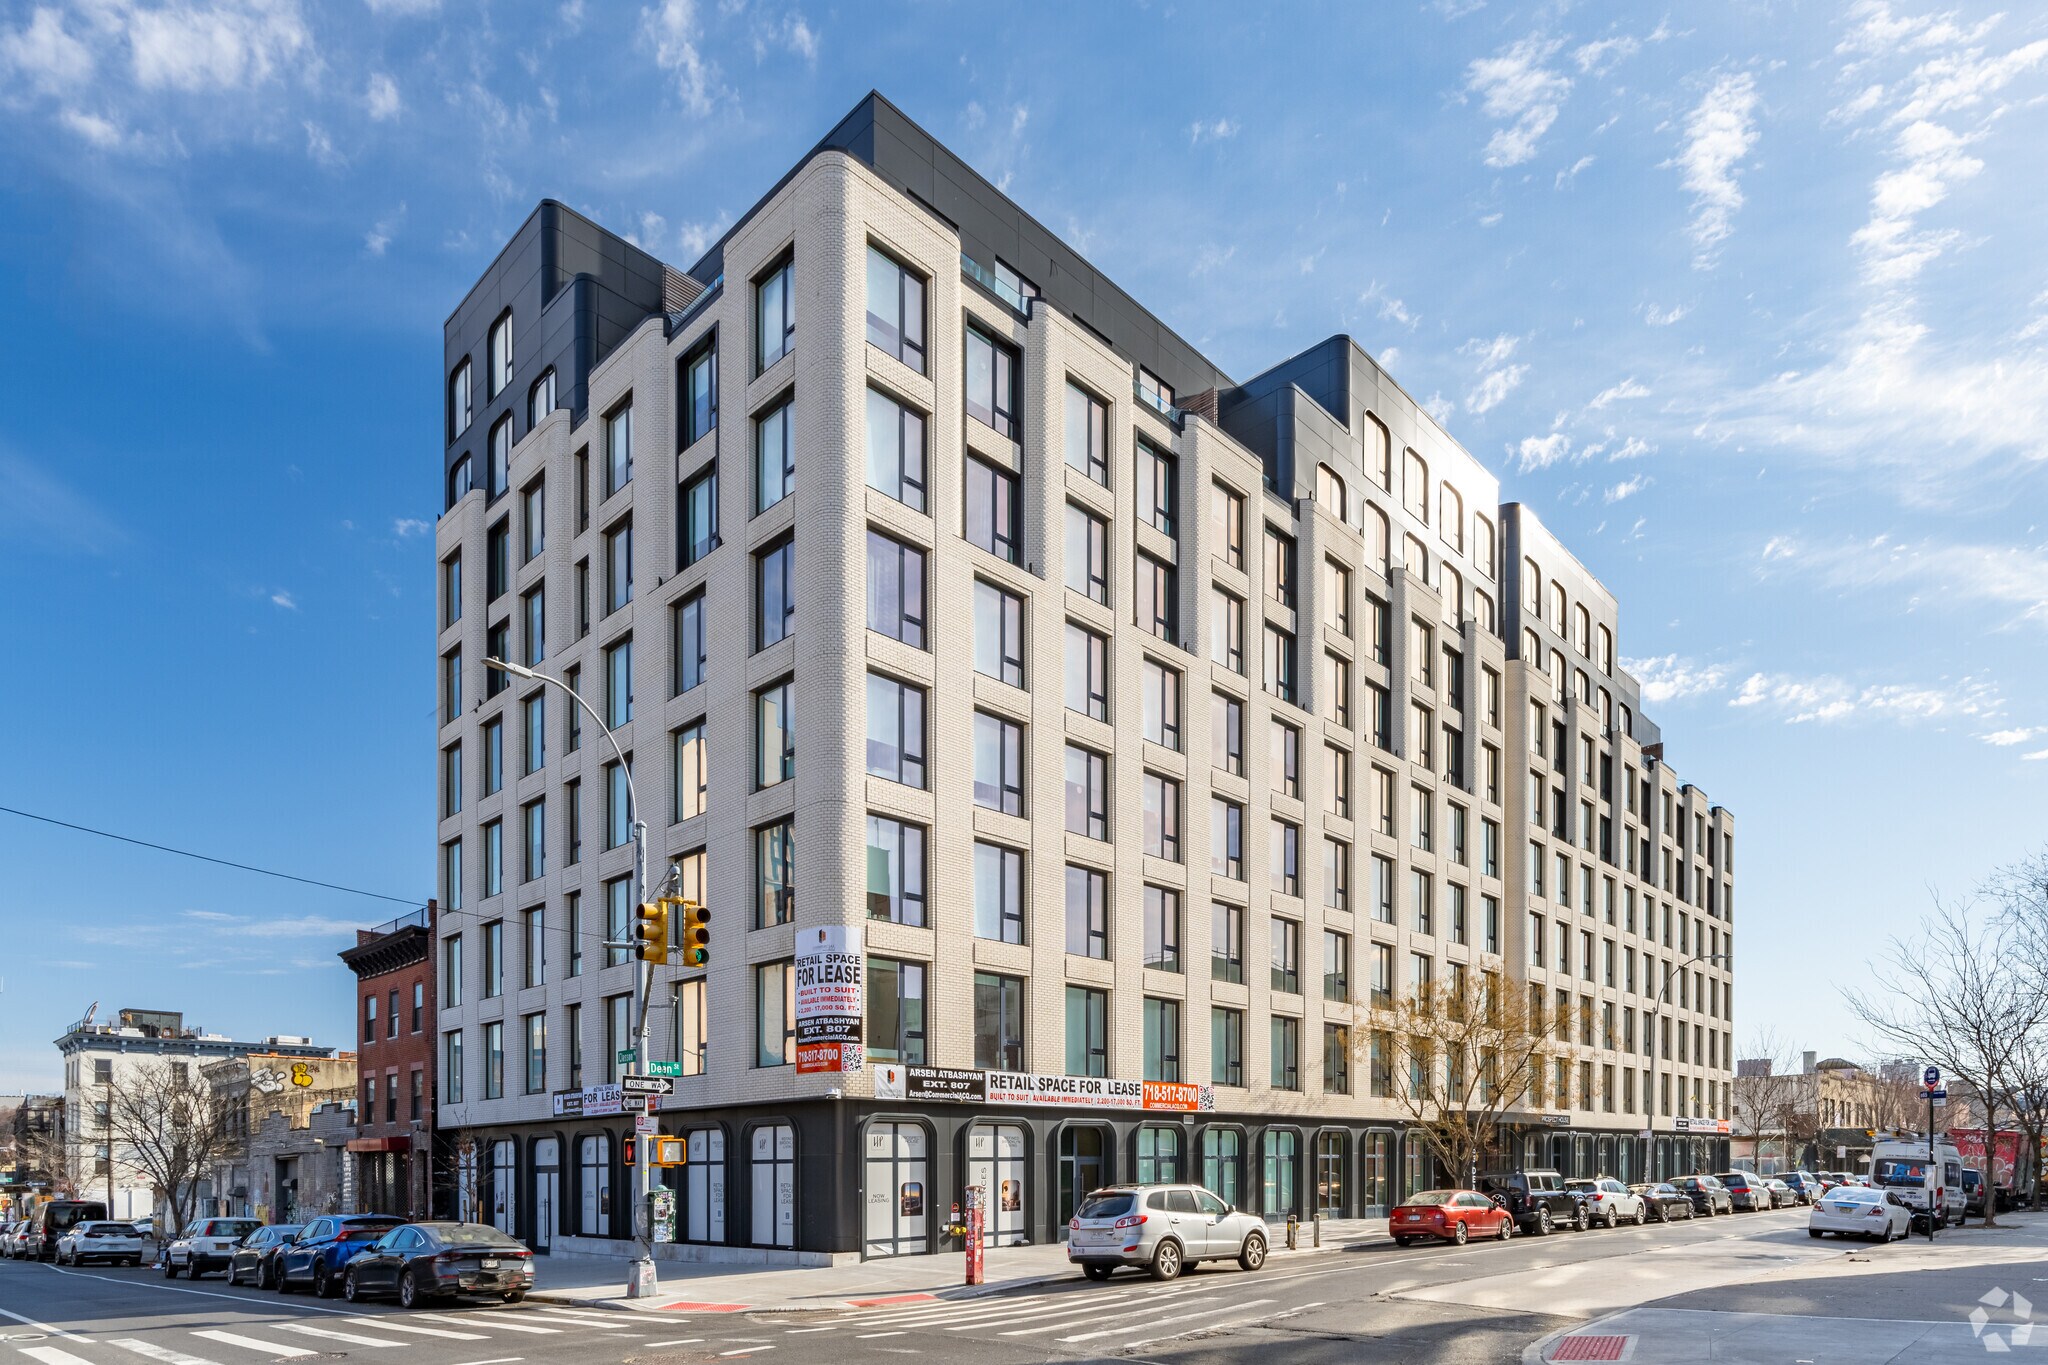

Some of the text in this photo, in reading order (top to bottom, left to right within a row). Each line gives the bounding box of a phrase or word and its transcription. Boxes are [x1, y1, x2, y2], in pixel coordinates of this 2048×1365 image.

[797, 954, 860, 968] RETAIL SPACE
[797, 965, 860, 987] FOR LEASE
[801, 988, 817, 996] BUILT
[820, 995, 856, 1003] IMMEDIATELY
[798, 1017, 860, 1028] ARSEN ATBASHYAN
[804, 1026, 822, 1035] EXT.
[798, 1049, 838, 1063] 718-517-8700
[650, 1063, 673, 1074] Dean
[909, 1068, 983, 1080] ARSEN ATBASHYAN
[651, 1082, 666, 1090] WAY
[923, 1080, 947, 1088] EXT.
[990, 1074, 1140, 1096] RETAIL SPACE FOR LEASE
[584, 1093, 598, 1103] FOR
[601, 1090, 621, 1102] LEAS
[1144, 1084, 1197, 1102] 718-517-8700
[1062, 1096, 1094, 1104] IMMEDIATELY
